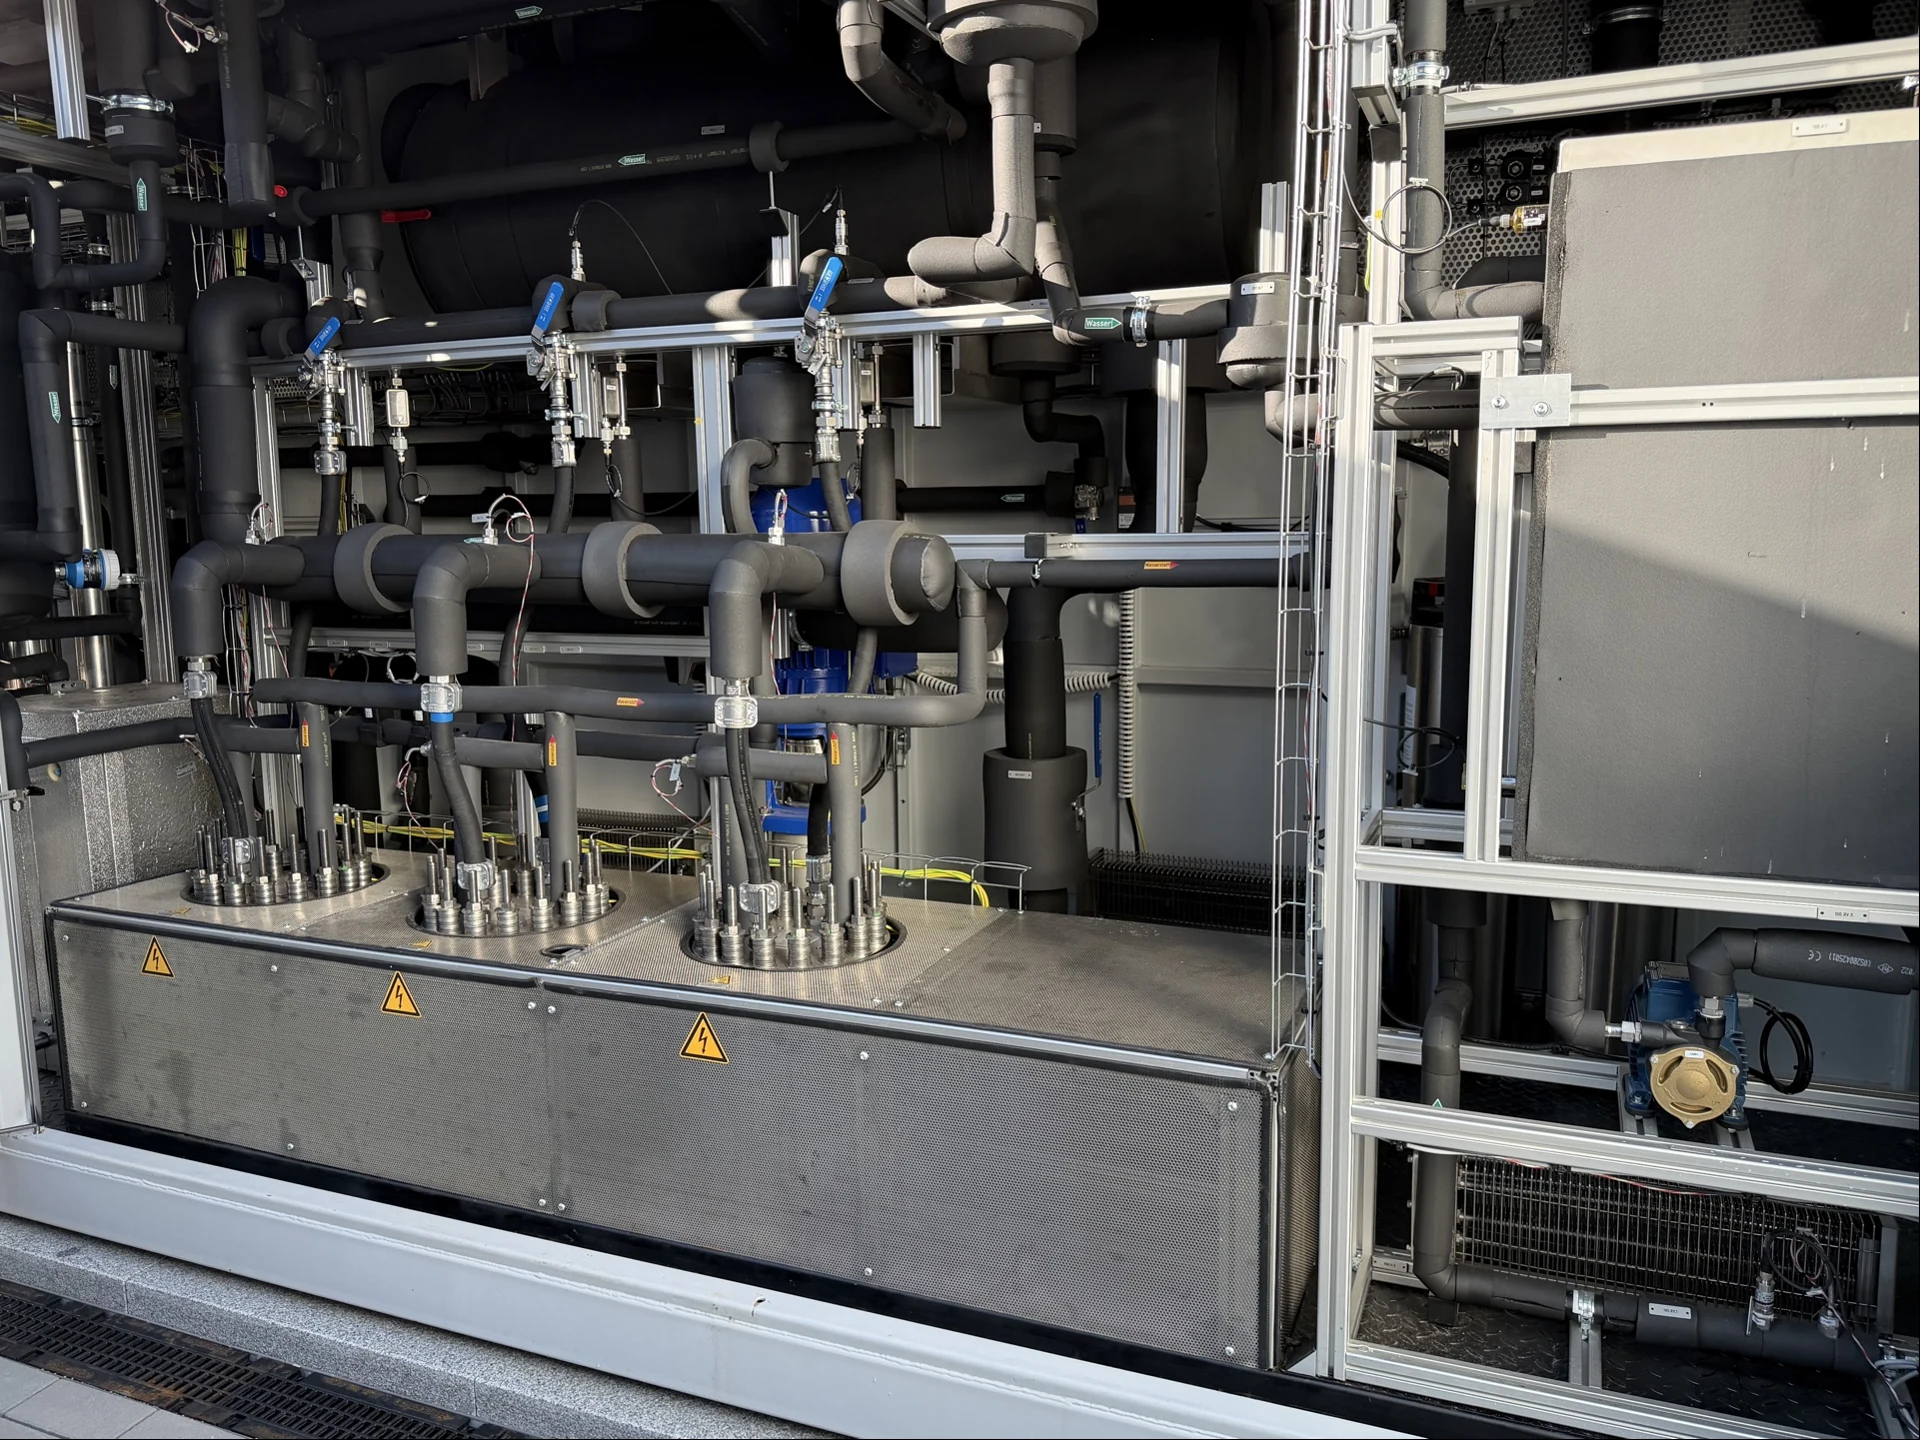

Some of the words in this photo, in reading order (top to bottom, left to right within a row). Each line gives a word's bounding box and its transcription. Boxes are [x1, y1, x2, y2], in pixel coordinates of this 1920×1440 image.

[1086, 319, 1112, 328] Wasser
[52, 393, 60, 416] Wasser
[1808, 949, 1822, 962] CE
